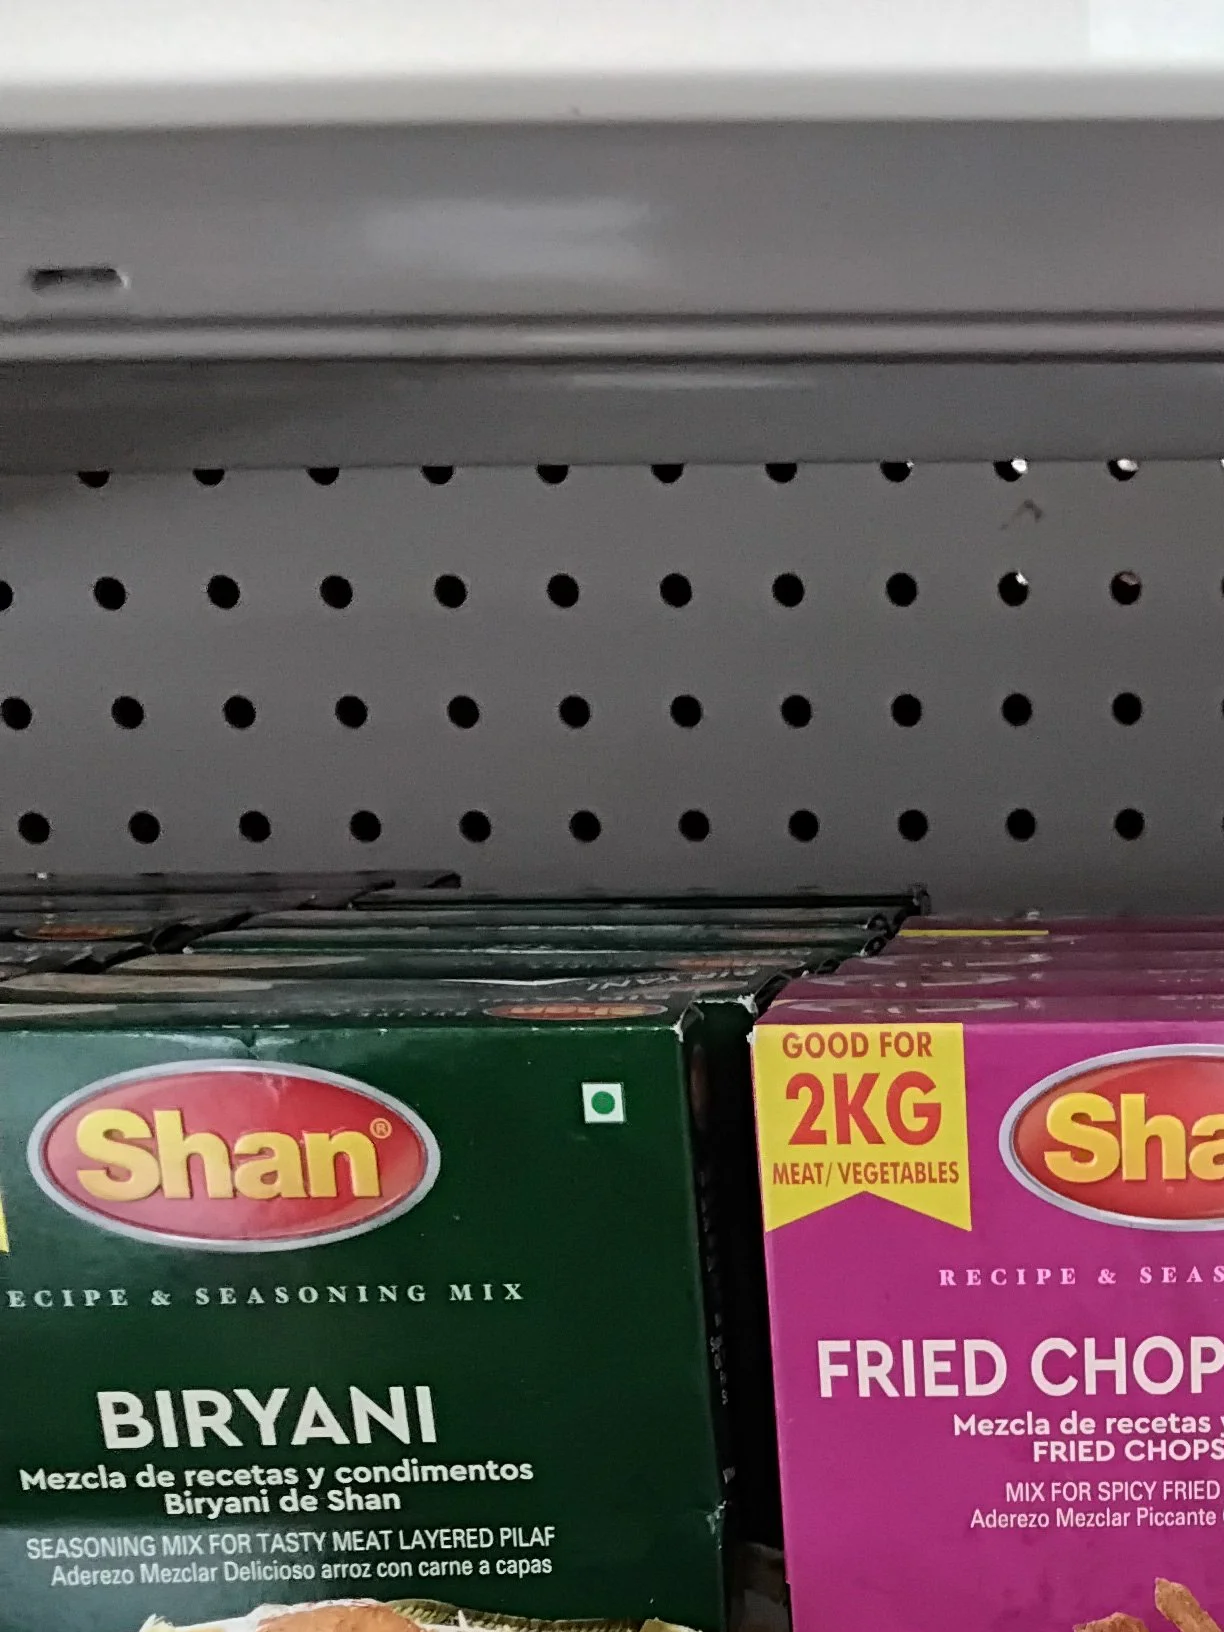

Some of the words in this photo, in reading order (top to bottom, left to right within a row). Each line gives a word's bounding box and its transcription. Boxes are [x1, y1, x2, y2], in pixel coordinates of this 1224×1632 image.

[783, 1032, 869, 1059] GOOD
[880, 1031, 932, 1058] FOR
[786, 1071, 941, 1145] 2KG
[773, 1162, 832, 1186] MEAT/
[837, 1161, 959, 1184] VEGETABLES
[939, 1268, 1075, 1285] RECIPE
[1098, 1269, 1116, 1284] &
[6, 1289, 128, 1307] ECIPE
[151, 1290, 170, 1305] &
[196, 1285, 425, 1305] SEASONING
[450, 1284, 523, 1300] MIX
[818, 1339, 1007, 1397] FRIED
[97, 1386, 436, 1449] BIRYANI
[954, 1411, 1050, 1435] Mezcla
[1060, 1410, 1095, 1434] de
[1106, 1413, 1211, 1434] recetas
[1034, 1441, 1115, 1462] FRIED
[20, 1465, 126, 1490] Mezcla
[136, 1464, 175, 1487] de
[184, 1465, 299, 1486] recetas
[306, 1467, 325, 1489] y
[335, 1458, 533, 1483] condimentos
[165, 1489, 270, 1519] Biryani
[279, 1488, 318, 1512] de
[327, 1487, 401, 1511] Shan
[1006, 1482, 1045, 1502] MIX
[1052, 1482, 1091, 1501] FOR
[1098, 1481, 1157, 1501] SPICY
[1163, 1480, 1220, 1500] FRIED
[971, 1509, 1049, 1528] Aderezo
[1057, 1507, 1130, 1527] Mezclar
[1137, 1507, 1216, 1526] Piccante
[27, 1535, 156, 1559] SEASONING
[162, 1535, 204, 1556] MIX
[209, 1534, 251, 1554] FOR
[255, 1532, 326, 1553] TASTY
[332, 1530, 393, 1551] MEAT
[399, 1528, 494, 1550] LAYERED
[500, 1526, 555, 1547] PILAF
[51, 1565, 134, 1586] Aderezo
[140, 1562, 218, 1583] Mezclar
[223, 1560, 317, 1582] Delicioso
[321, 1563, 372, 1578] arroz
[377, 1562, 413, 1577] con
[418, 1560, 473, 1576] carne
[479, 1560, 490, 1575] a
[496, 1558, 552, 1578] capas
